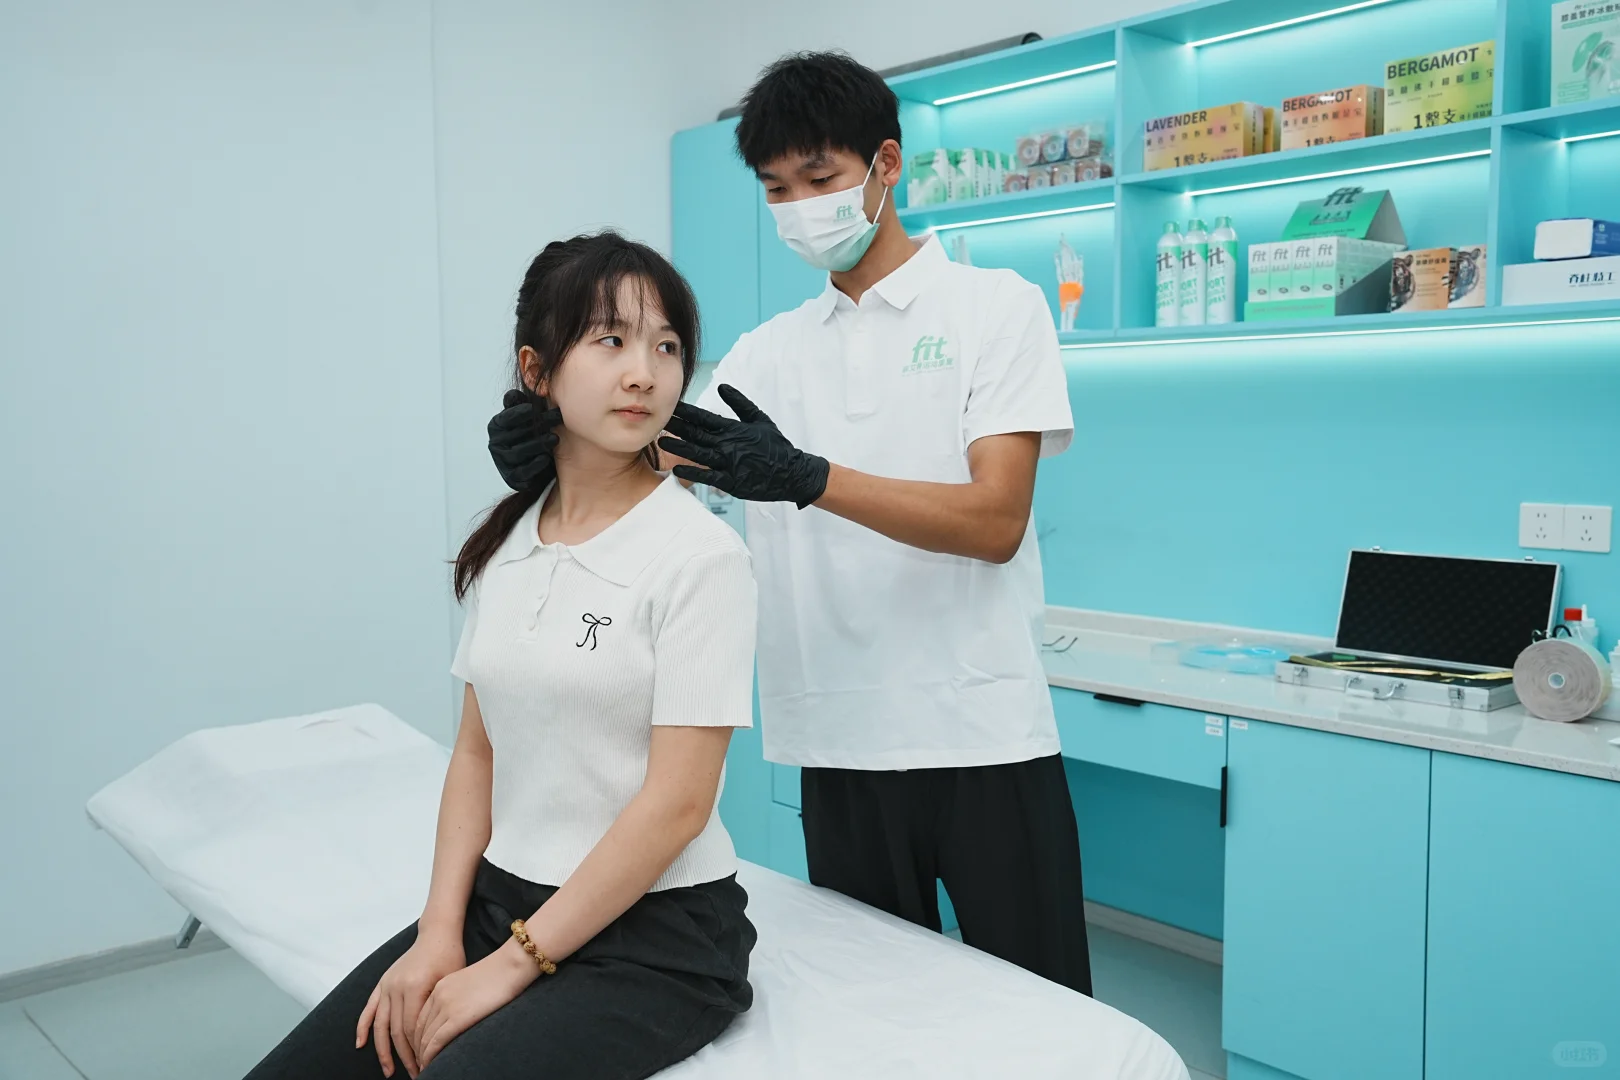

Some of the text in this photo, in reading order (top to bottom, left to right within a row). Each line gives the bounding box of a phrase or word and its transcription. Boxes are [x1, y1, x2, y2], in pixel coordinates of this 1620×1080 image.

[1387, 47, 1479, 80] BERGAMOT
[1283, 89, 1353, 112] BERGAMOT
[1146, 110, 1207, 133] LAVENDER
[1323, 186, 1364, 207] fit
[836, 204, 852, 219] fit
[1181, 249, 1196, 269] it
[1208, 247, 1224, 267] it
[1252, 250, 1266, 262] fit
[1273, 248, 1288, 260] fit
[1295, 245, 1311, 258] fit
[1317, 243, 1333, 256] fit
[1156, 252, 1173, 272] it
[912, 335, 947, 363] fit
